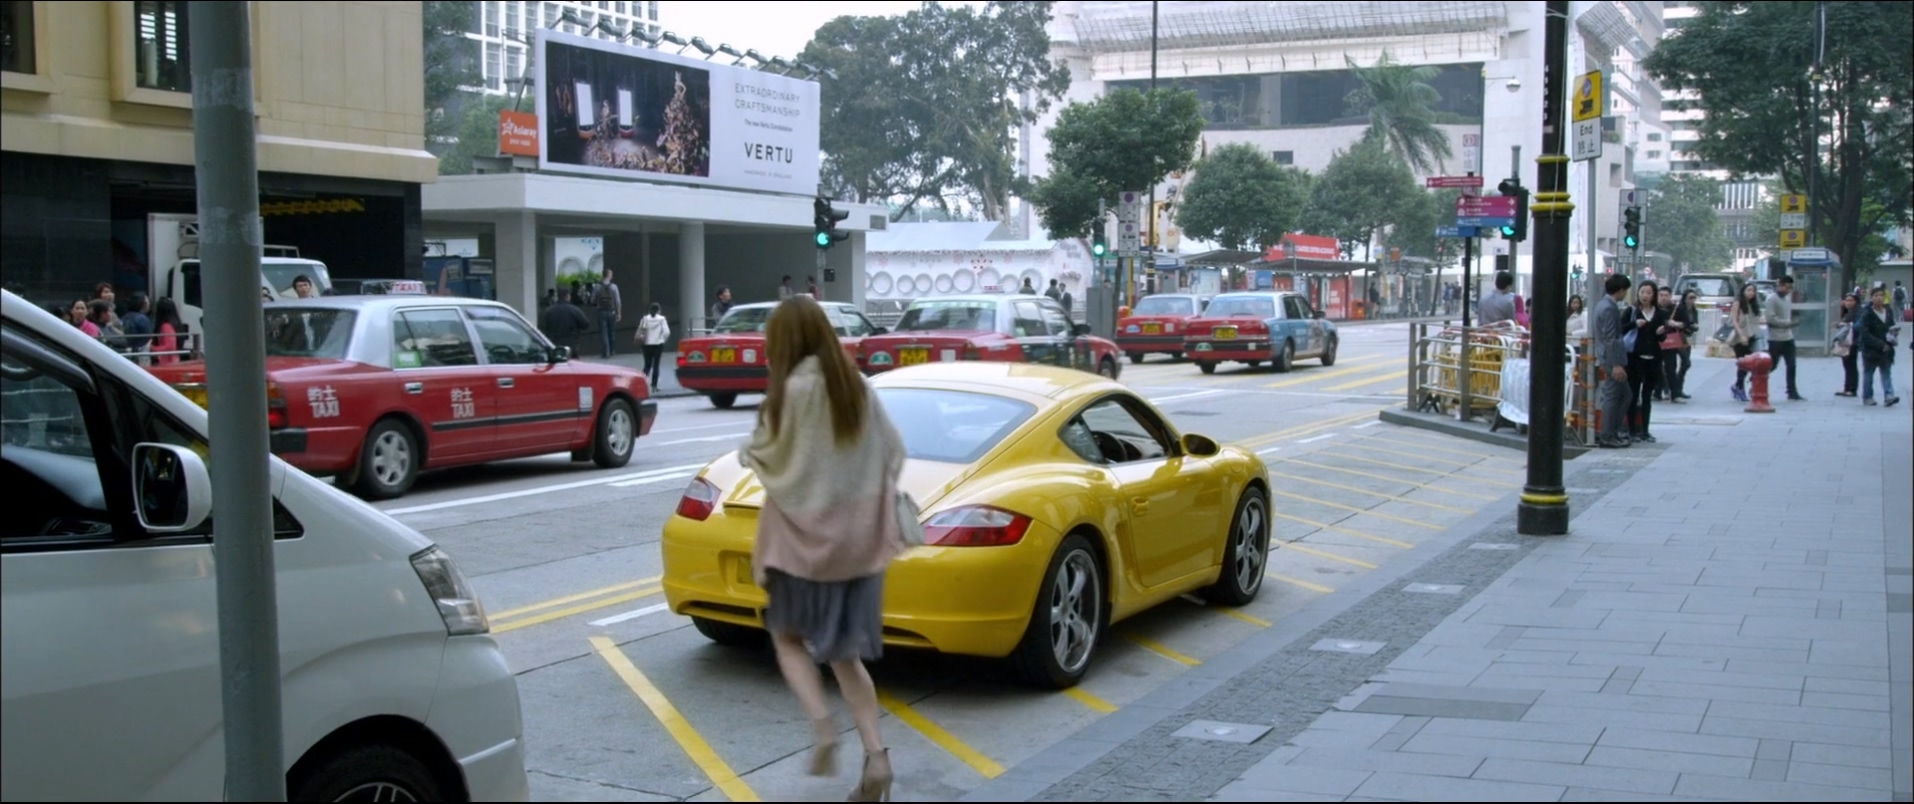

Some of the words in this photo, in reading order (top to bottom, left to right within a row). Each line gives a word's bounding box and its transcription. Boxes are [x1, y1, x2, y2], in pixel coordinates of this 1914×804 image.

[735, 83, 800, 103] EXTRAORDINARY
[735, 99, 800, 117] CRAFTSMANSHIP
[1580, 124, 1593, 136] End
[744, 142, 793, 164] VERTU
[307, 385, 337, 402] 的士
[450, 387, 473, 402] 的士
[309, 401, 340, 418] TAXI
[451, 402, 475, 418] TAXI
